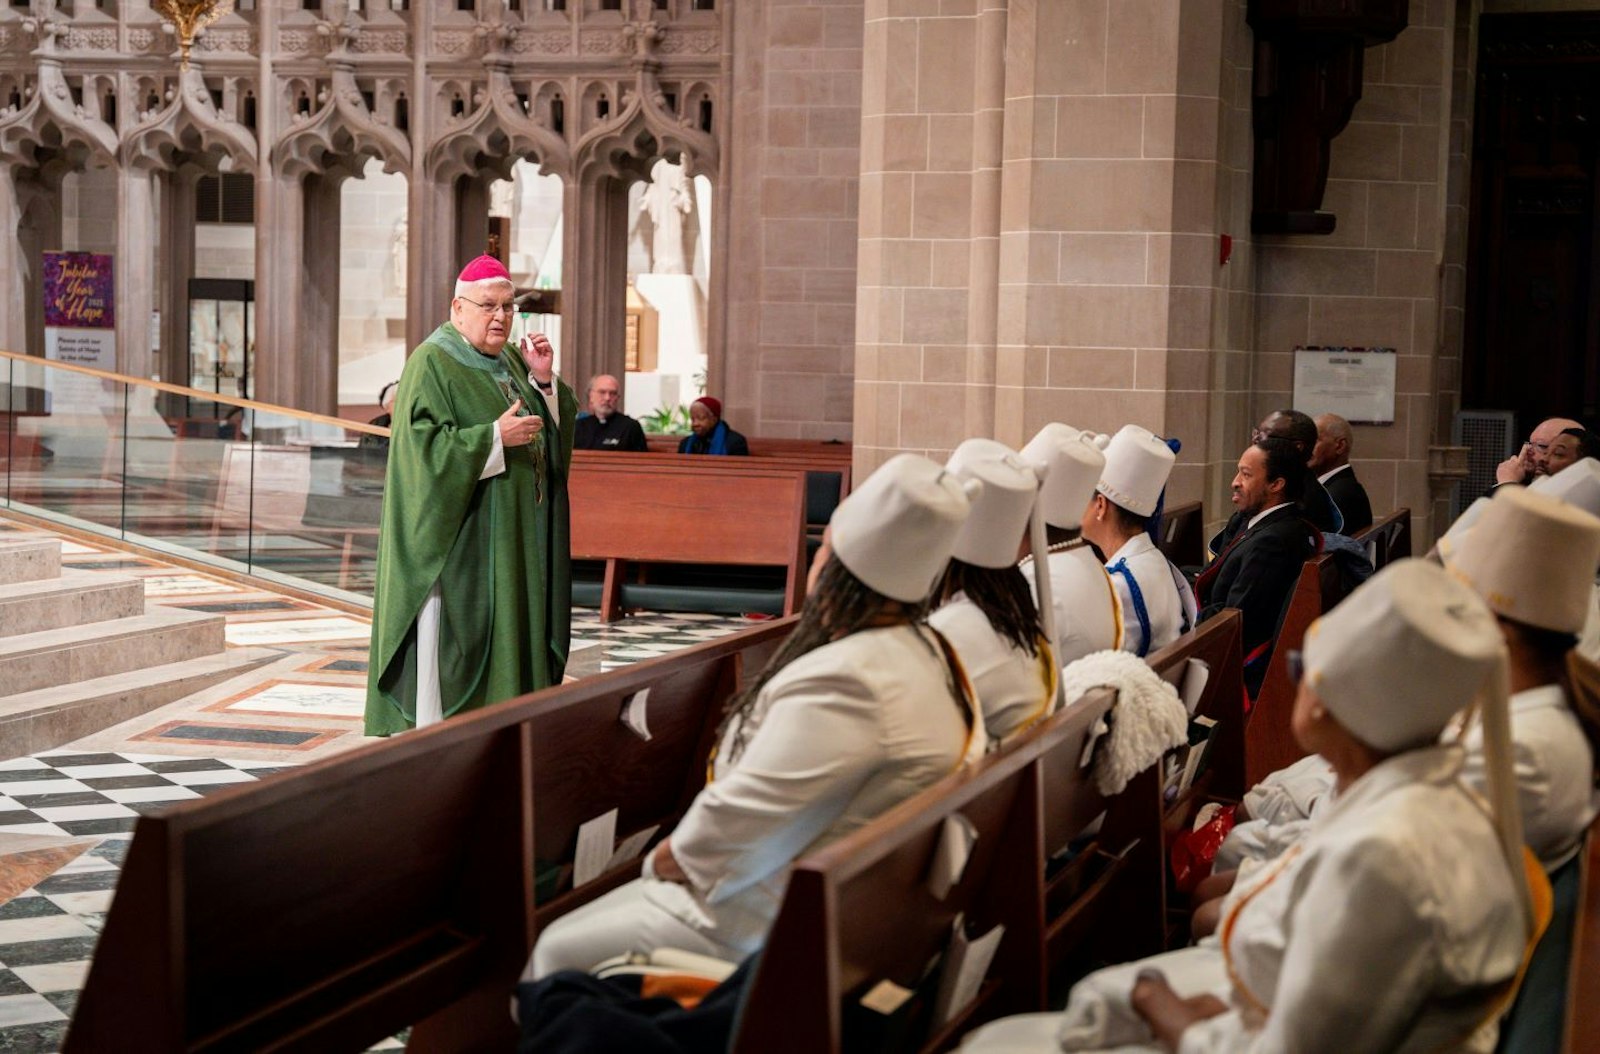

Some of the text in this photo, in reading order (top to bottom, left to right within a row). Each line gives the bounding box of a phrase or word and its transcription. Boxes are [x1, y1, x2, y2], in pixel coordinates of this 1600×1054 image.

[66, 278, 95, 301] Year
[55, 294, 104, 323] of Hope
[58, 336, 76, 344] Please
